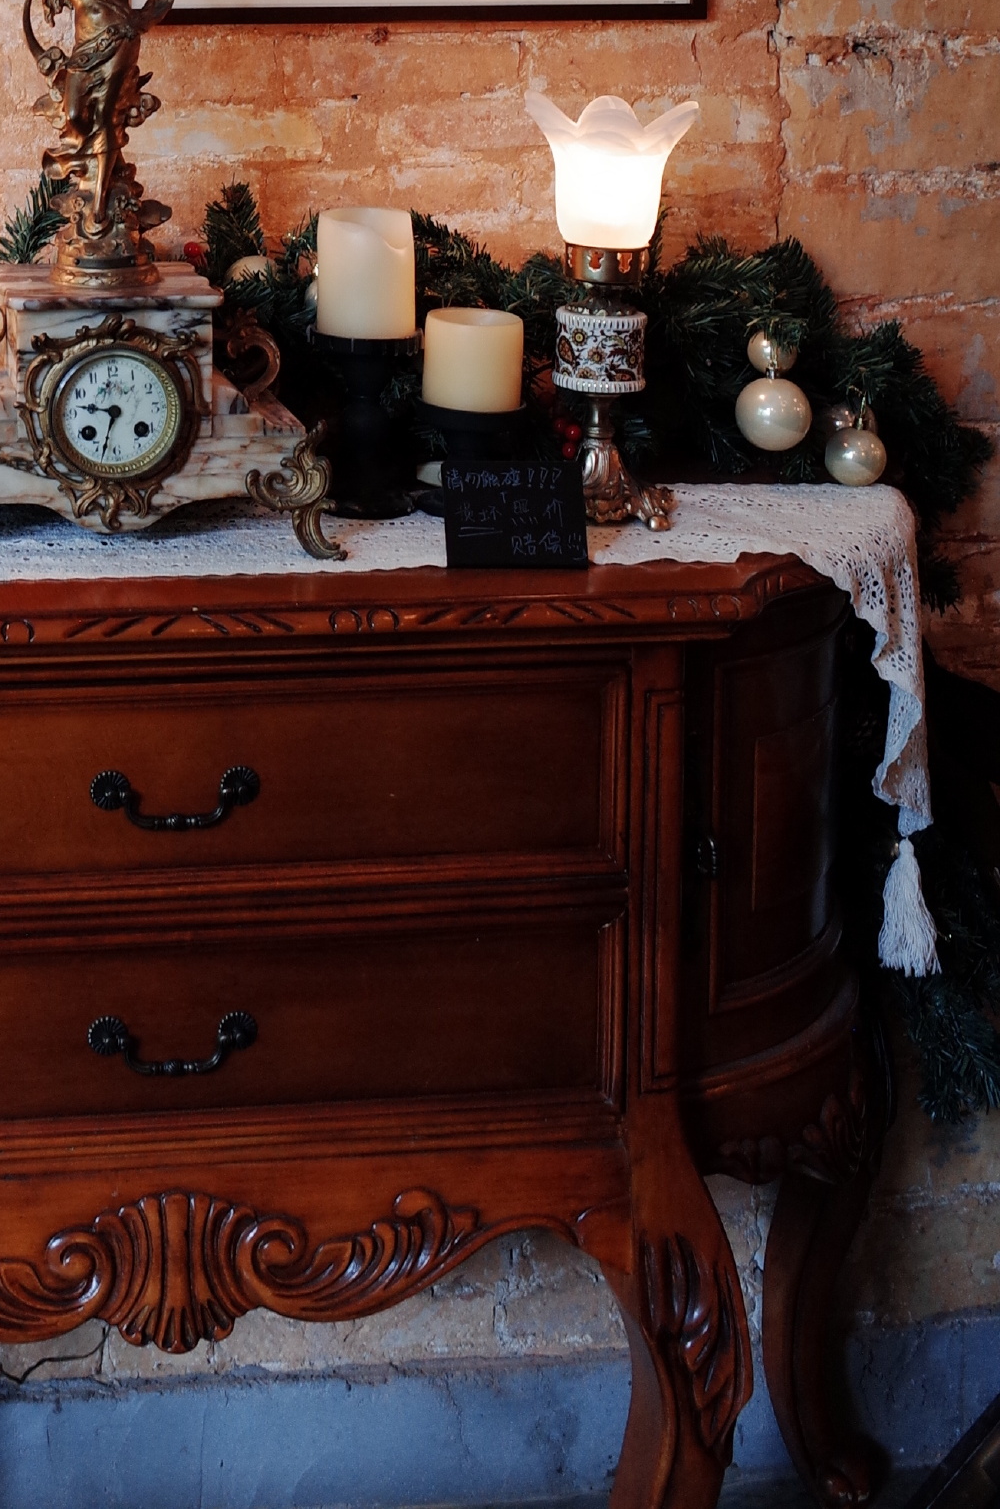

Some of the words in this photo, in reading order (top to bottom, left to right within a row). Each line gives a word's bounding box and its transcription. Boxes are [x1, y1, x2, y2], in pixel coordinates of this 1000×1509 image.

[89, 371, 98, 384] 11
[107, 365, 119, 378] 12
[74, 387, 86, 400] 10
[144, 382, 153, 395] 2
[69, 408, 78, 420] 9
[92, 440, 100, 453] 7
[112, 444, 122, 456] 6
[133, 437, 141, 450] 5
